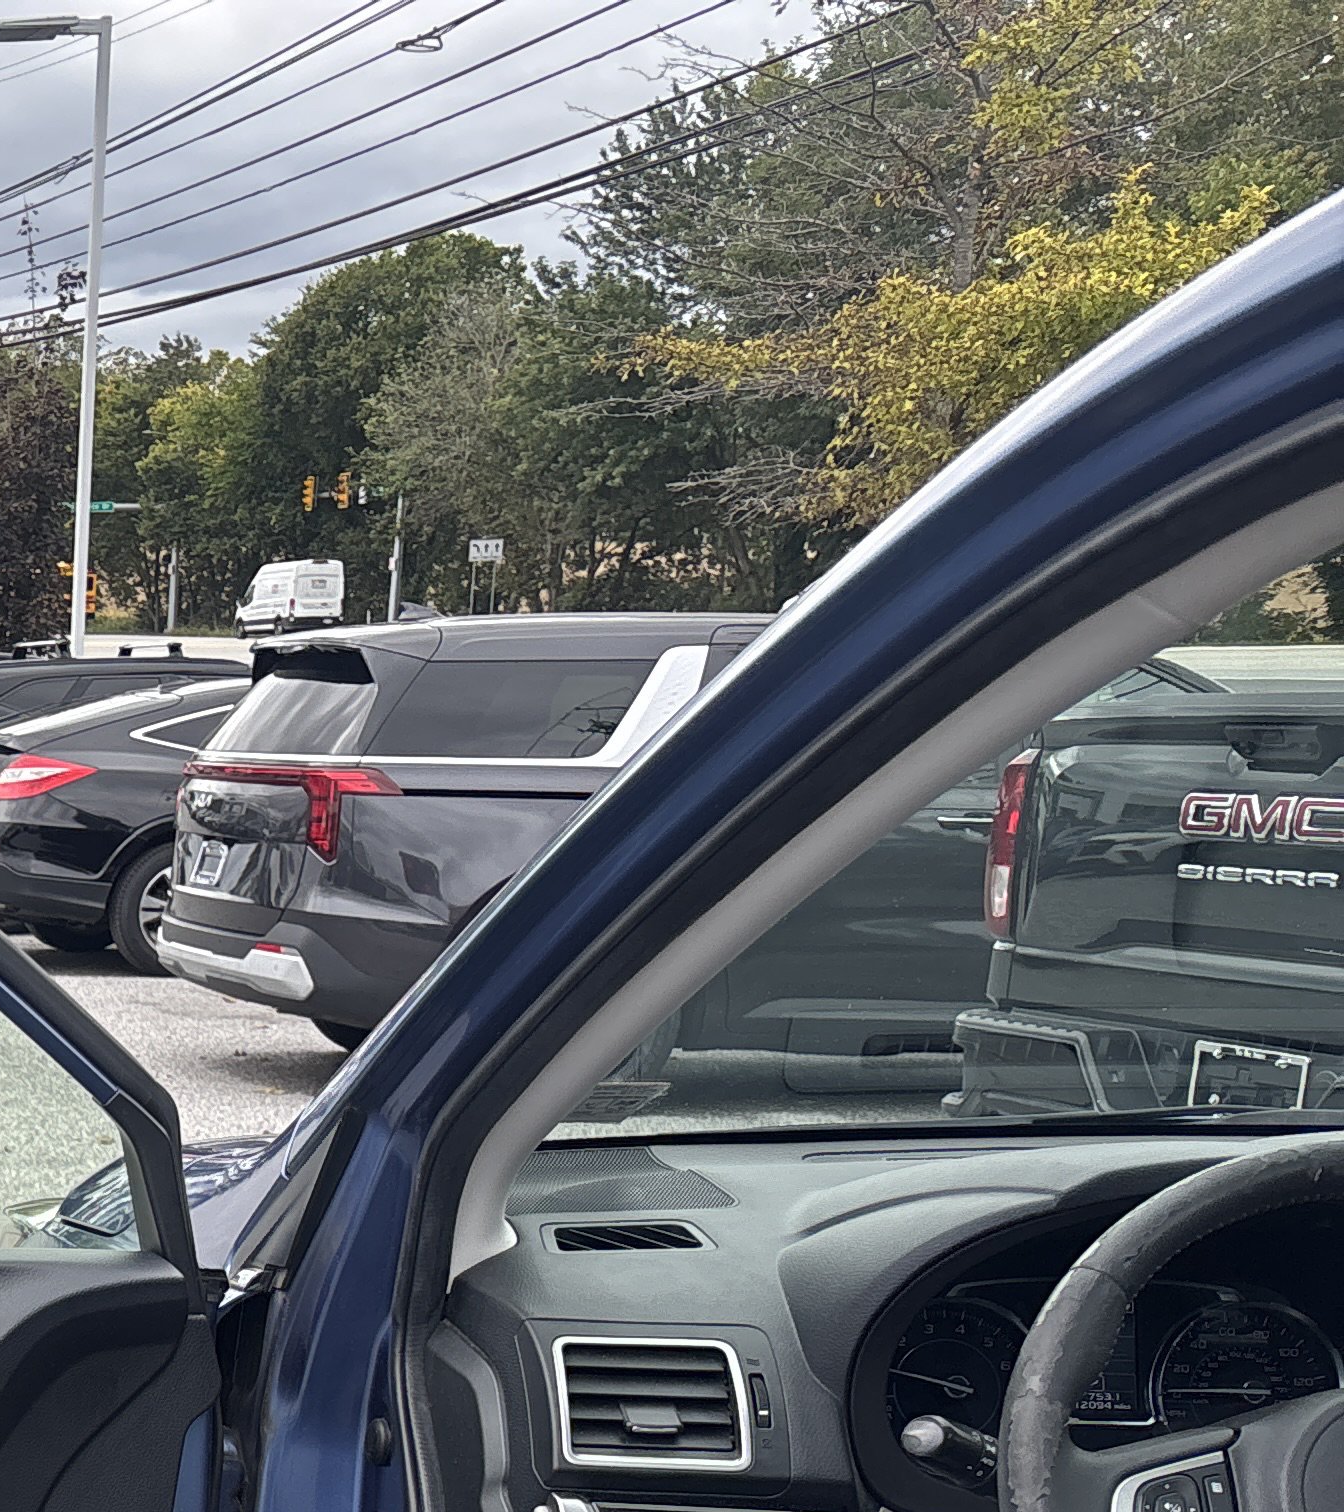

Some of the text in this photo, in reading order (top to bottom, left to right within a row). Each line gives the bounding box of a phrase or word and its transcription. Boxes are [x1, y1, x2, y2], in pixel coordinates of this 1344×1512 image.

[1179, 791, 1344, 843] GMC
[1177, 863, 1340, 889] SIERRA
[923, 1324, 934, 1335] 3
[954, 1324, 966, 1335] 4
[1000, 1360, 1012, 1371] 6
